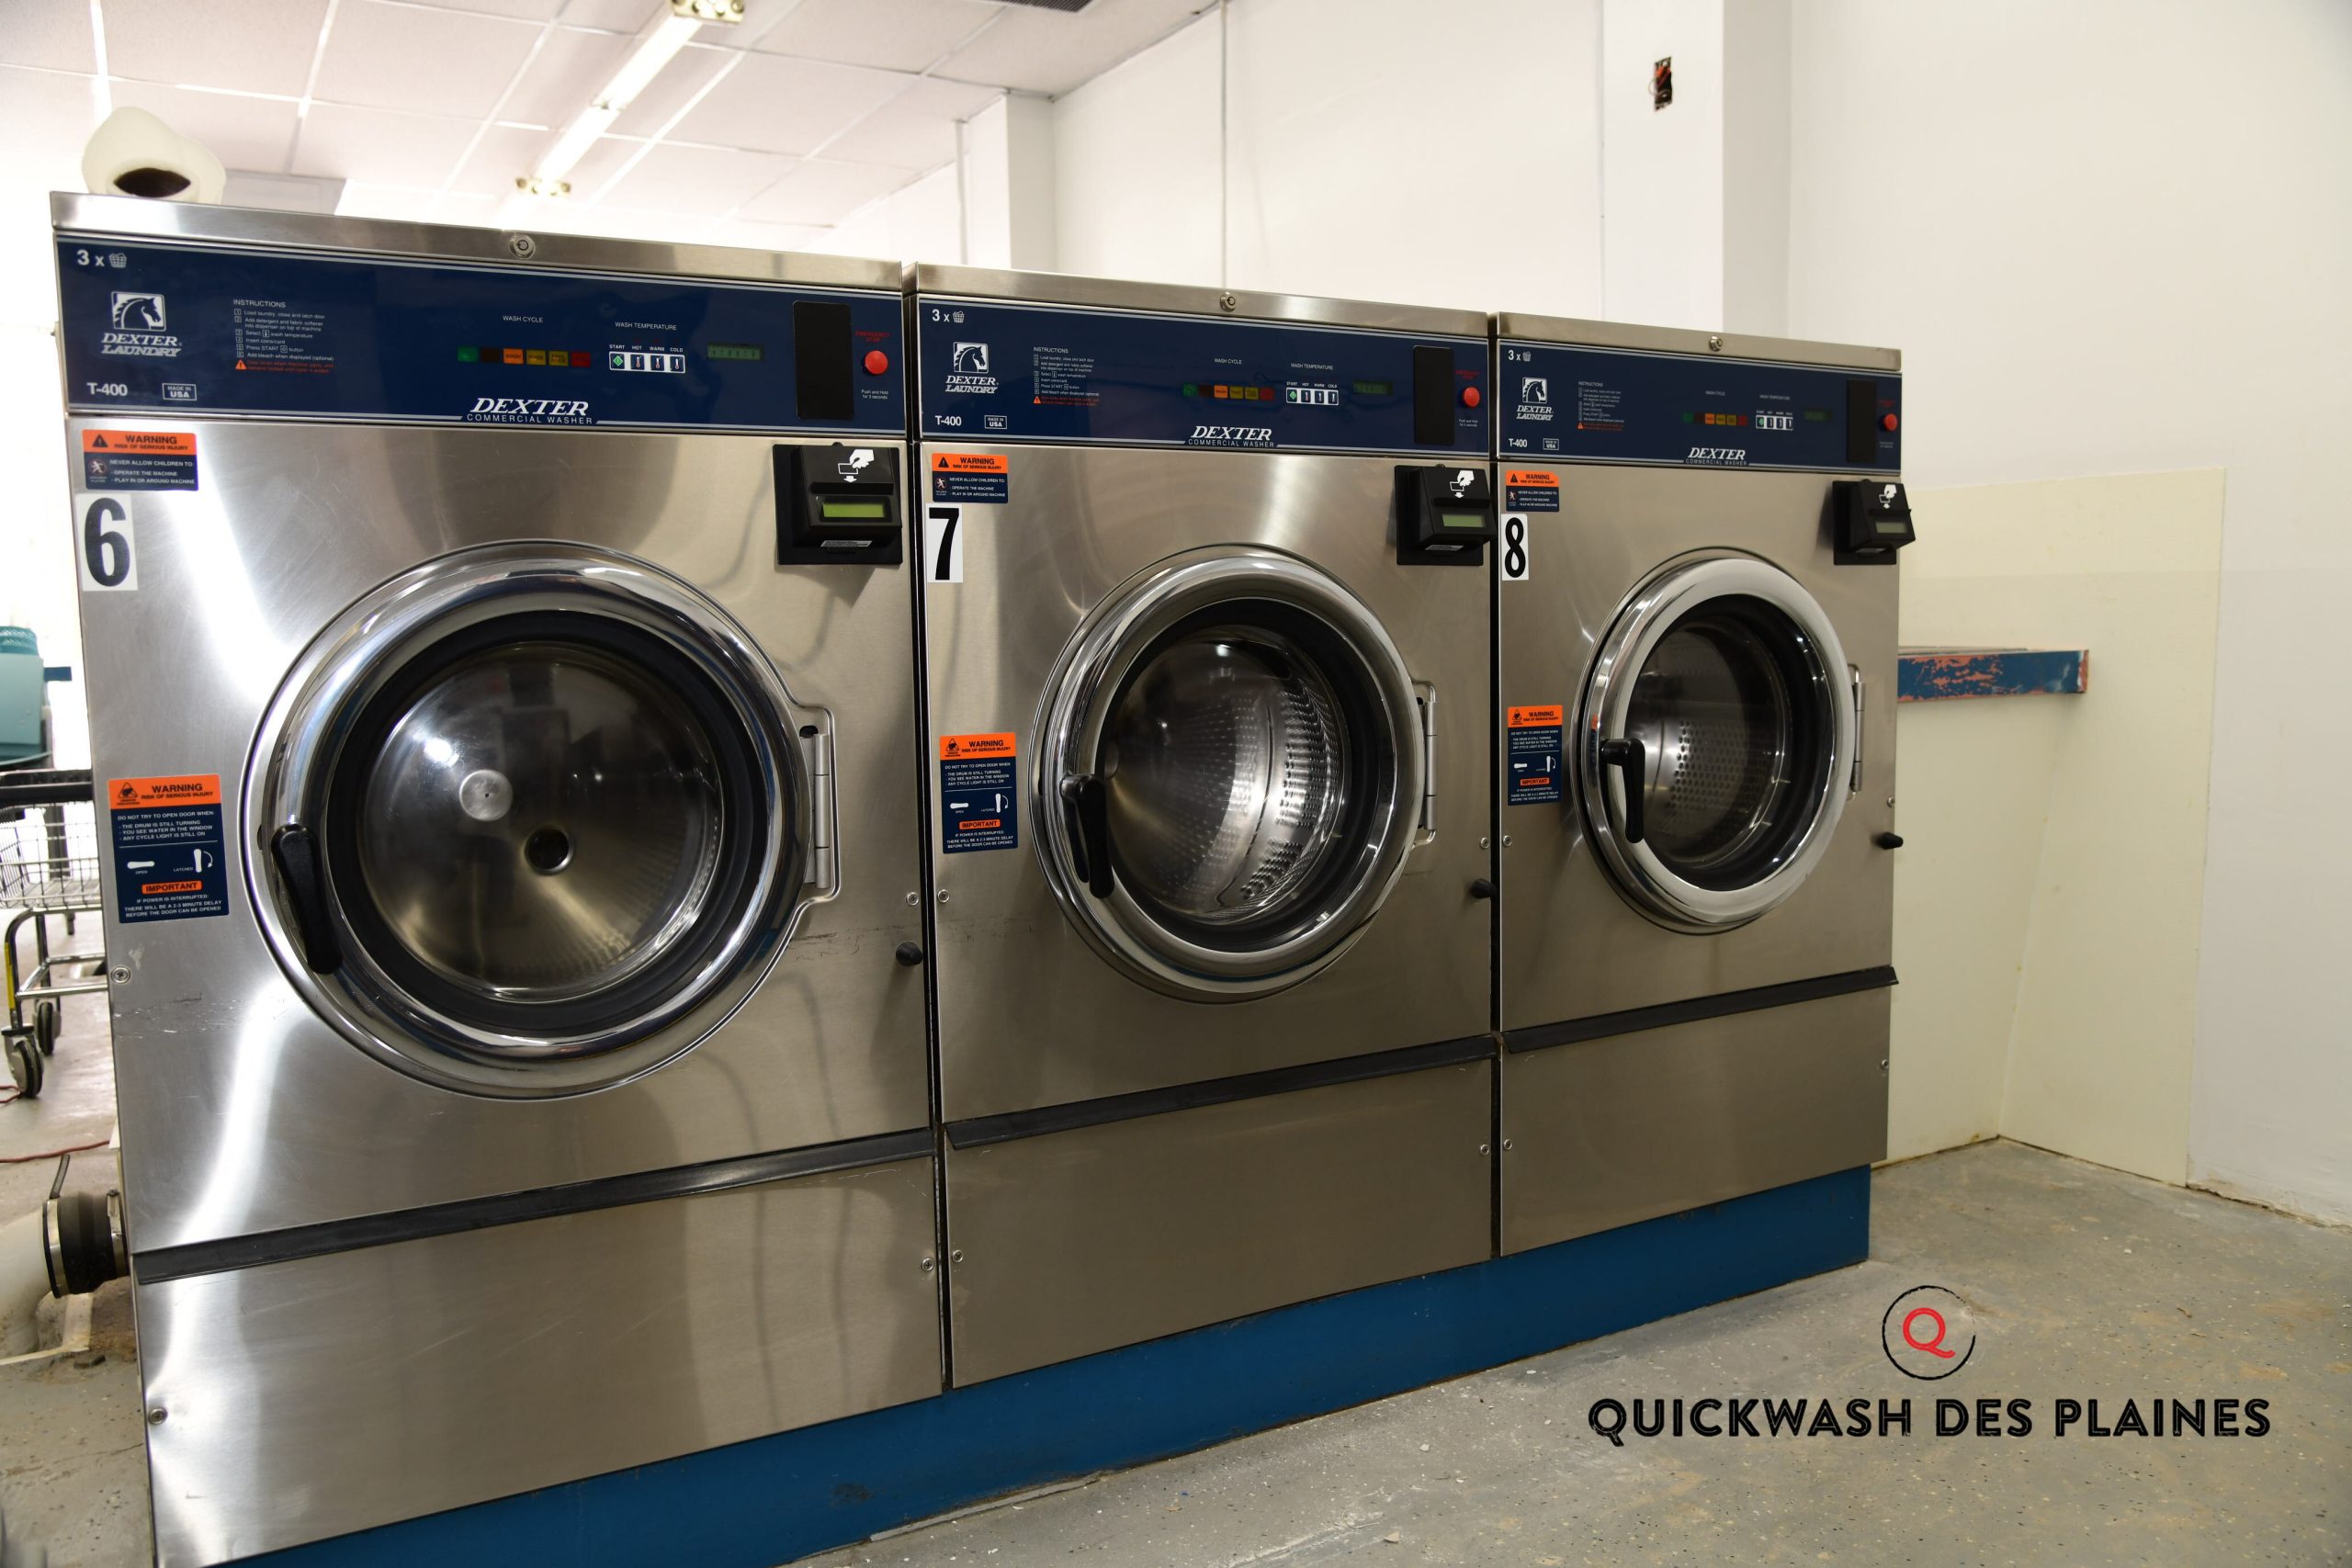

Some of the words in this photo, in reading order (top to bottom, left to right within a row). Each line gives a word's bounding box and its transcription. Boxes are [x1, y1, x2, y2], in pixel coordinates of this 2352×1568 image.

[77, 250, 90, 266] 3
[233, 299, 287, 308] INSTRUCTIONS
[933, 309, 940, 321] 3
[634, 322, 676, 331] TEMPERATURE
[101, 333, 178, 345] DEXTER
[101, 344, 181, 357] LAUNDRY
[1508, 350, 1514, 360] 3
[945, 375, 996, 385] DEXTER
[87, 383, 128, 397] T-400
[944, 384, 998, 394] LAUNDRY
[470, 398, 589, 415] DEXTER
[1517, 405, 1552, 413] DEXTER
[467, 413, 542, 423] COMMERCIAL
[548, 416, 592, 424] WASHER
[935, 415, 962, 426] T-400
[1191, 426, 1272, 441] DEXTER
[125, 435, 177, 444] WARNING
[1509, 438, 1527, 447] T-400
[1688, 447, 1746, 460] DEXTER
[85, 498, 130, 587] 6
[929, 507, 959, 580] 7
[1505, 517, 1526, 578] 8
[152, 784, 202, 793] WARNING
[146, 882, 198, 892] IMPORTANT
